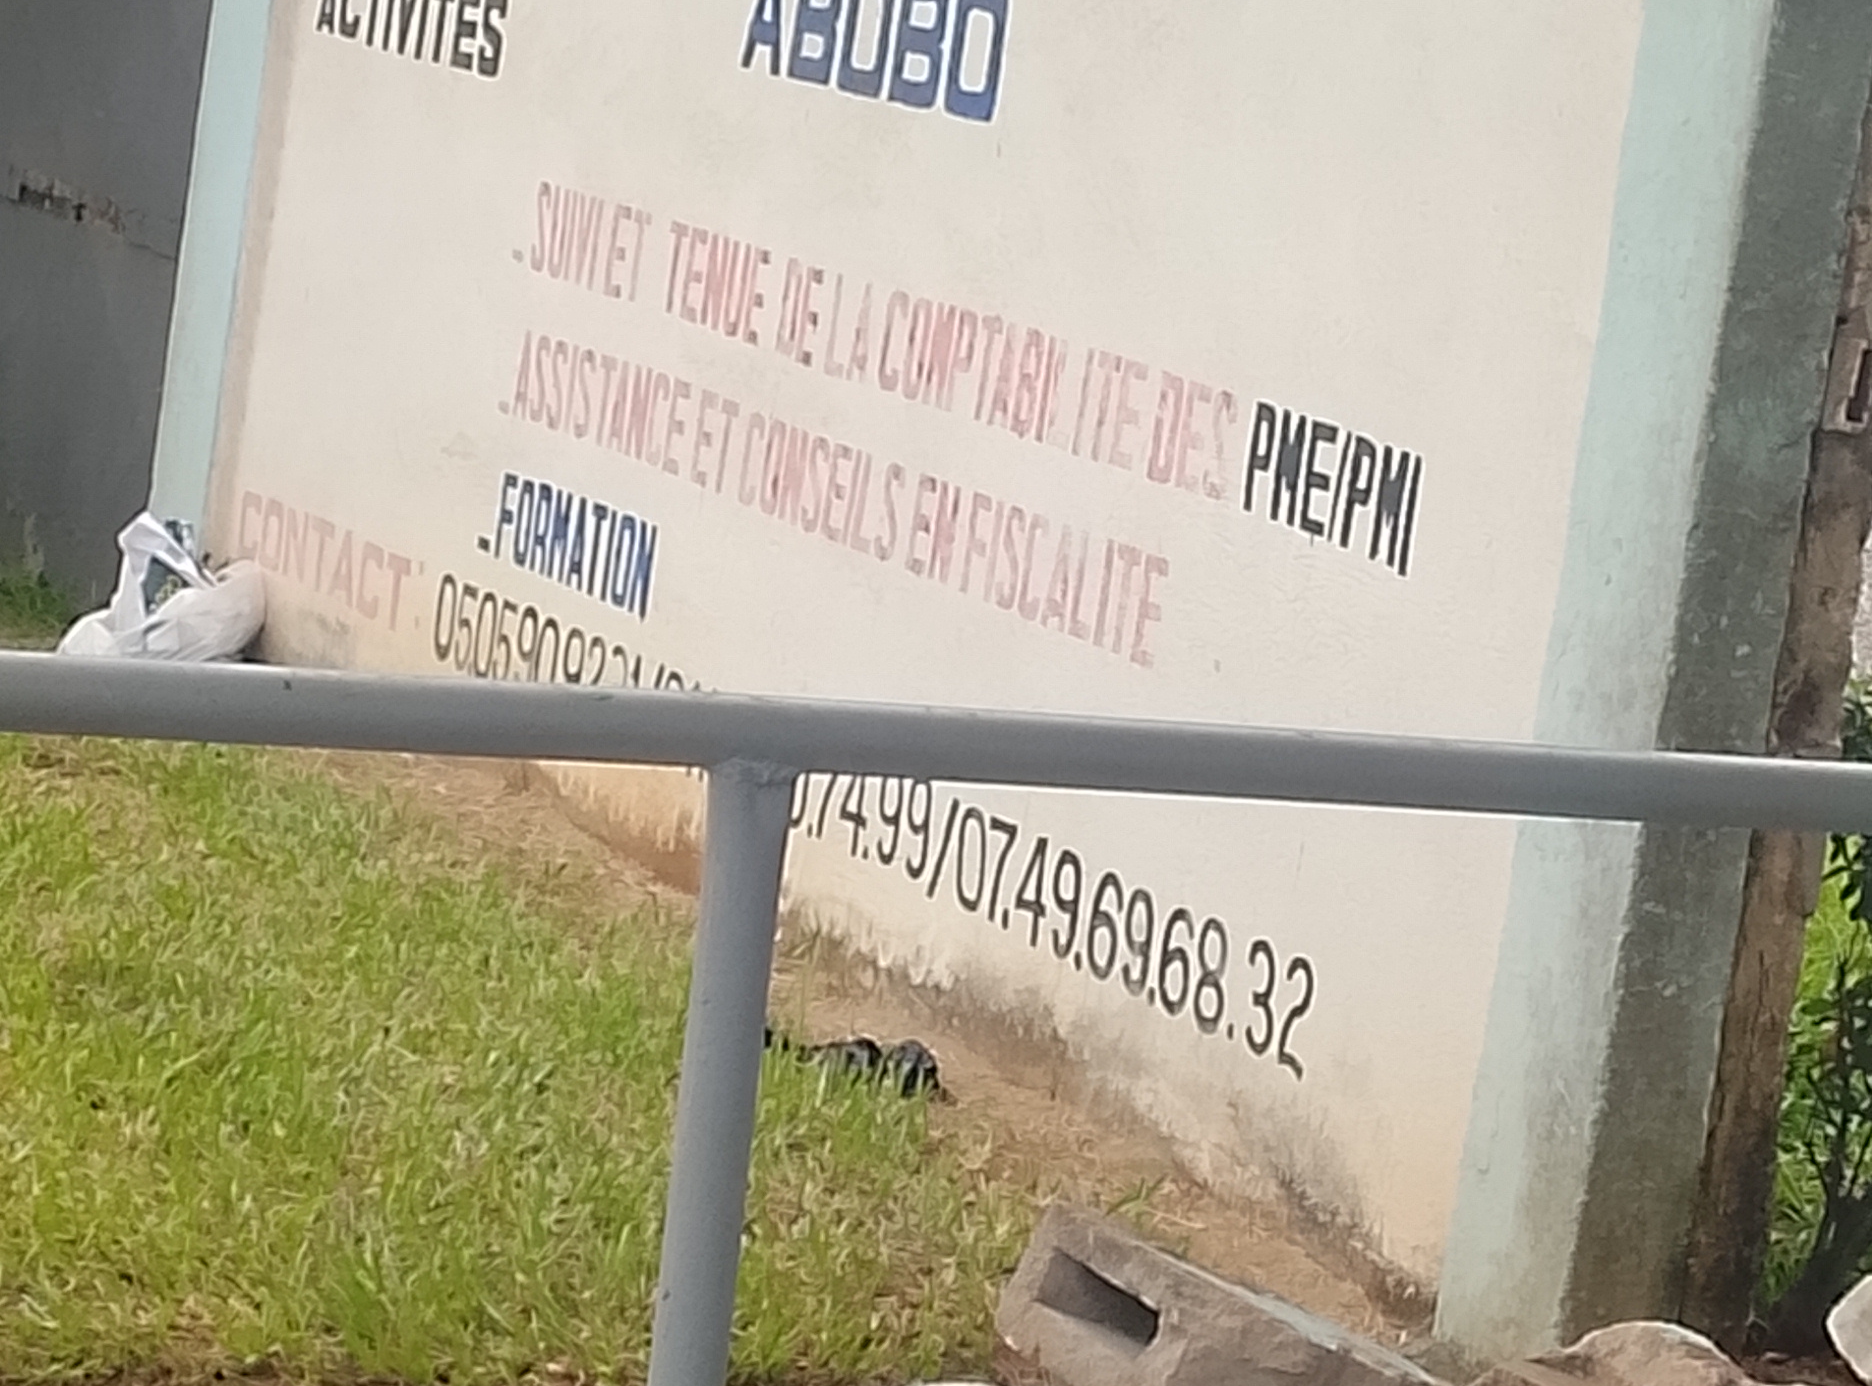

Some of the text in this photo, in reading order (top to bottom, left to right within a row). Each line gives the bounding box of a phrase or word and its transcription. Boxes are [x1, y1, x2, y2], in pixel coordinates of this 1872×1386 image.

[603, 204, 652, 301] ET
[666, 219, 771, 346] TENUE
[776, 257, 824, 367] DE
[824, 273, 873, 382] LA
[878, 289, 1148, 471] COMPTABILITE
[1147, 371, 1238, 501] DES
[1242, 400, 1423, 579] PME/PMI
[690, 389, 740, 495] ET
[738, 413, 906, 562] CONSEILS
[906, 473, 961, 583] EN
[958, 491, 1169, 668] FISCALITE
